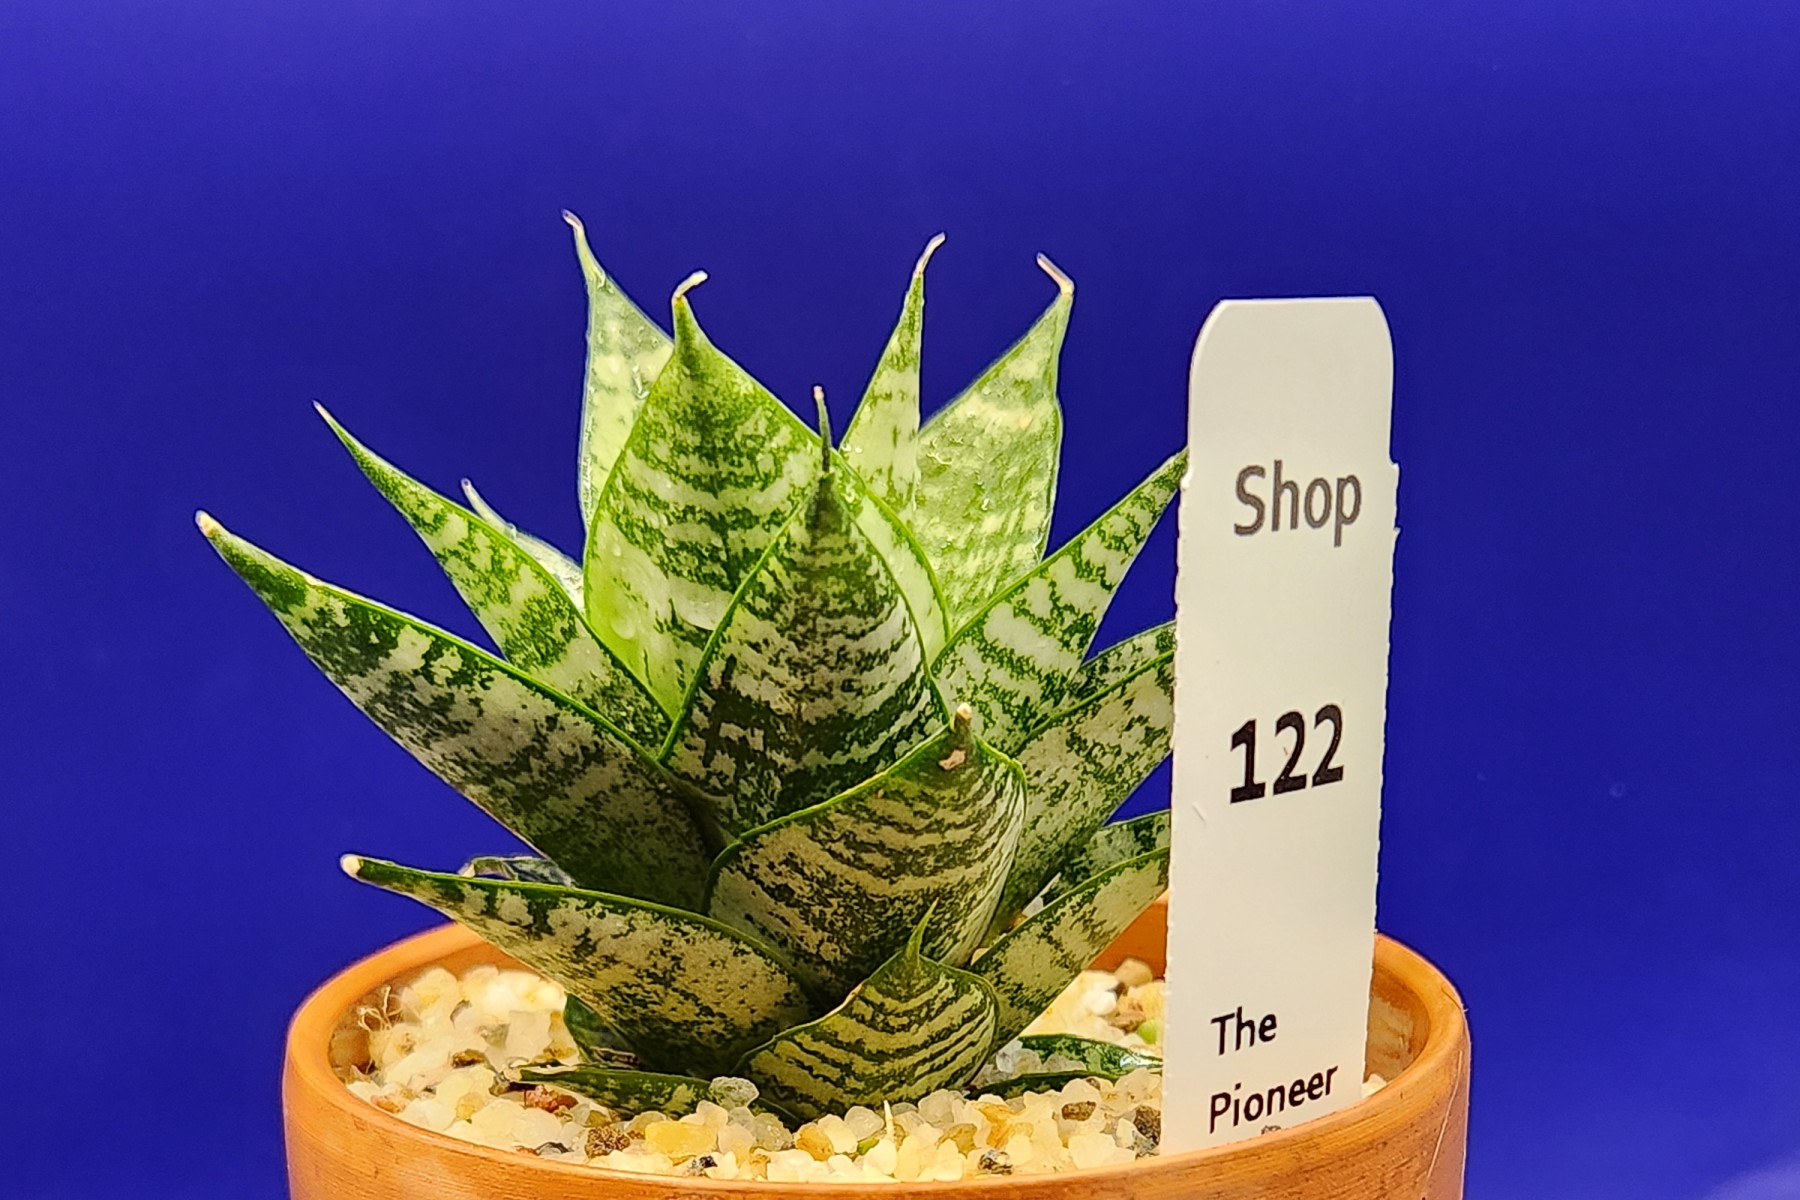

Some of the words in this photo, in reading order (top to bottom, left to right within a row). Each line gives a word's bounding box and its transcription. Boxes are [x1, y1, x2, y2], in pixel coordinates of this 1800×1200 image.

[1234, 459, 1362, 547] Shop
[1230, 703, 1344, 804] 122
[1211, 1006, 1277, 1055] The
[1210, 1066, 1338, 1134] Pioneer
